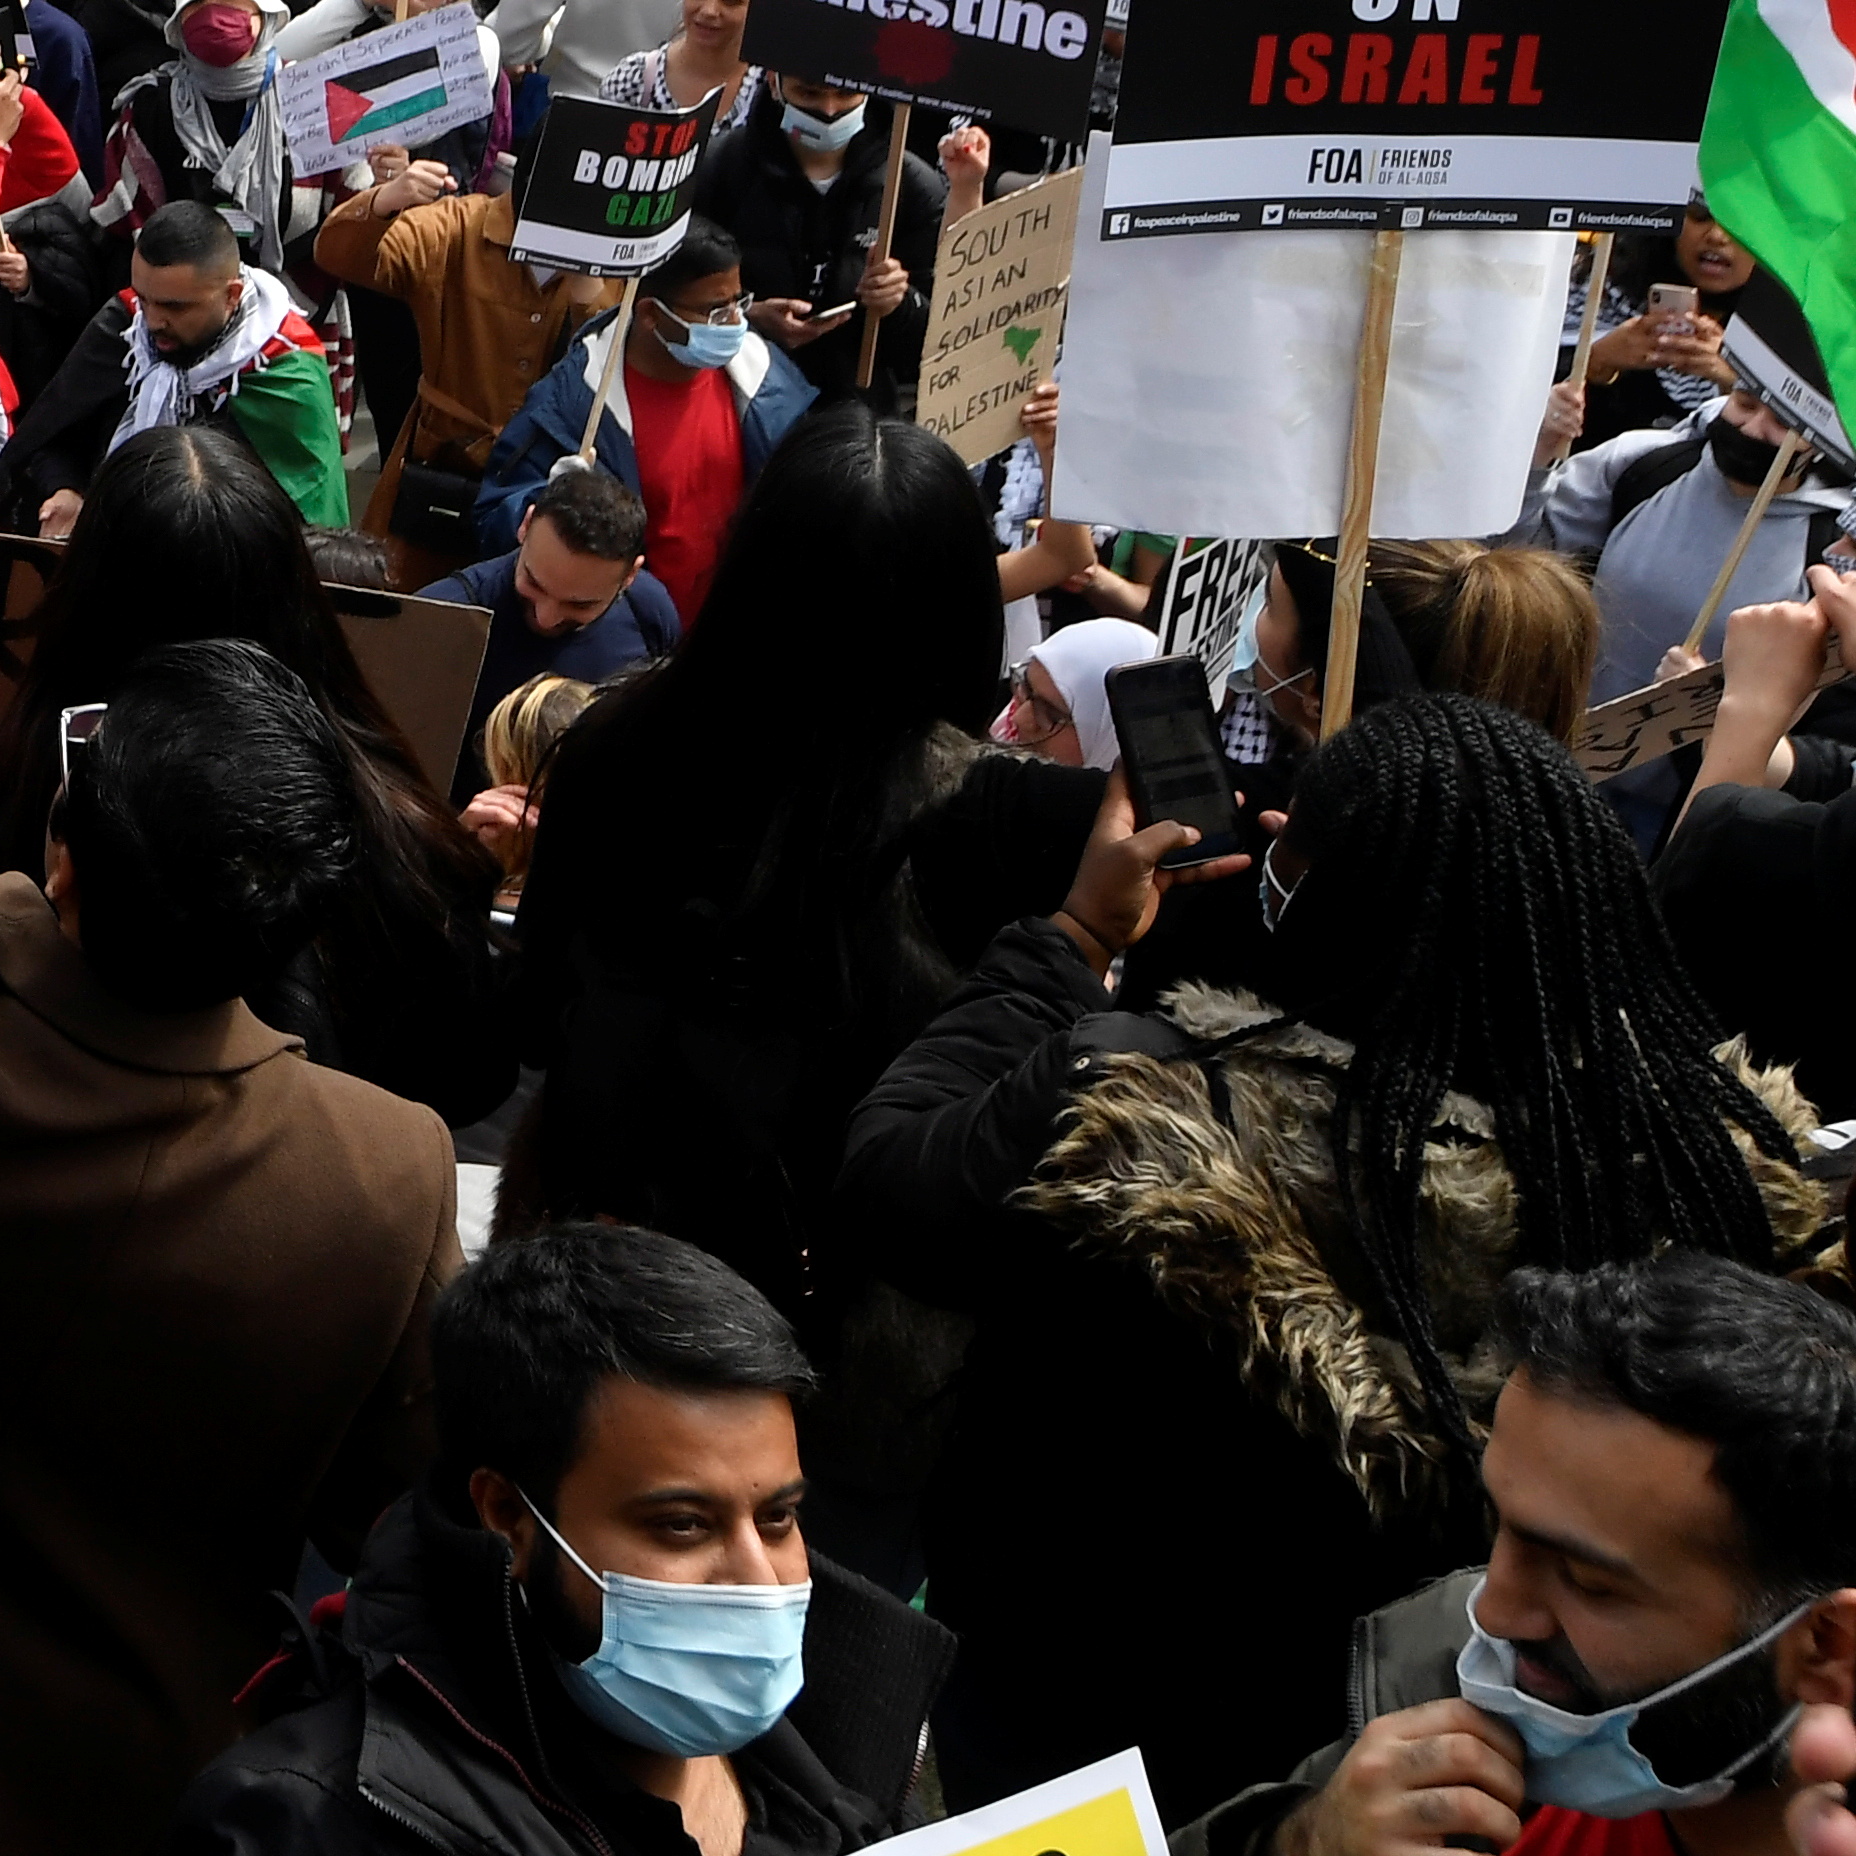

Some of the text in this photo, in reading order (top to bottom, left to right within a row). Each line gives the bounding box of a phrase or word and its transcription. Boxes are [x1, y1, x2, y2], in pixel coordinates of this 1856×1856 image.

[1248, 32, 1543, 106] ISRAEL
[573, 142, 699, 189] BOMBIN
[1308, 147, 1363, 186] FOA
[1378, 169, 1449, 186] OF AL-AQSA
[1381, 147, 1452, 171] FRIENDS
[605, 191, 675, 229] GAZA
[1133, 209, 1241, 226] foapeaceinpalestine
[1287, 206, 1378, 224] friendsofalaqsa
[1426, 207, 1518, 225] friendsofalaqsa
[1583, 211, 1674, 229] friendsofalaqsa
[948, 204, 1052, 279] SOUTH
[942, 257, 1028, 321] ASIAN
[937, 282, 1066, 363] SOLIDARITY
[928, 363, 962, 396] FOR
[924, 365, 1038, 438] PALESTINE
